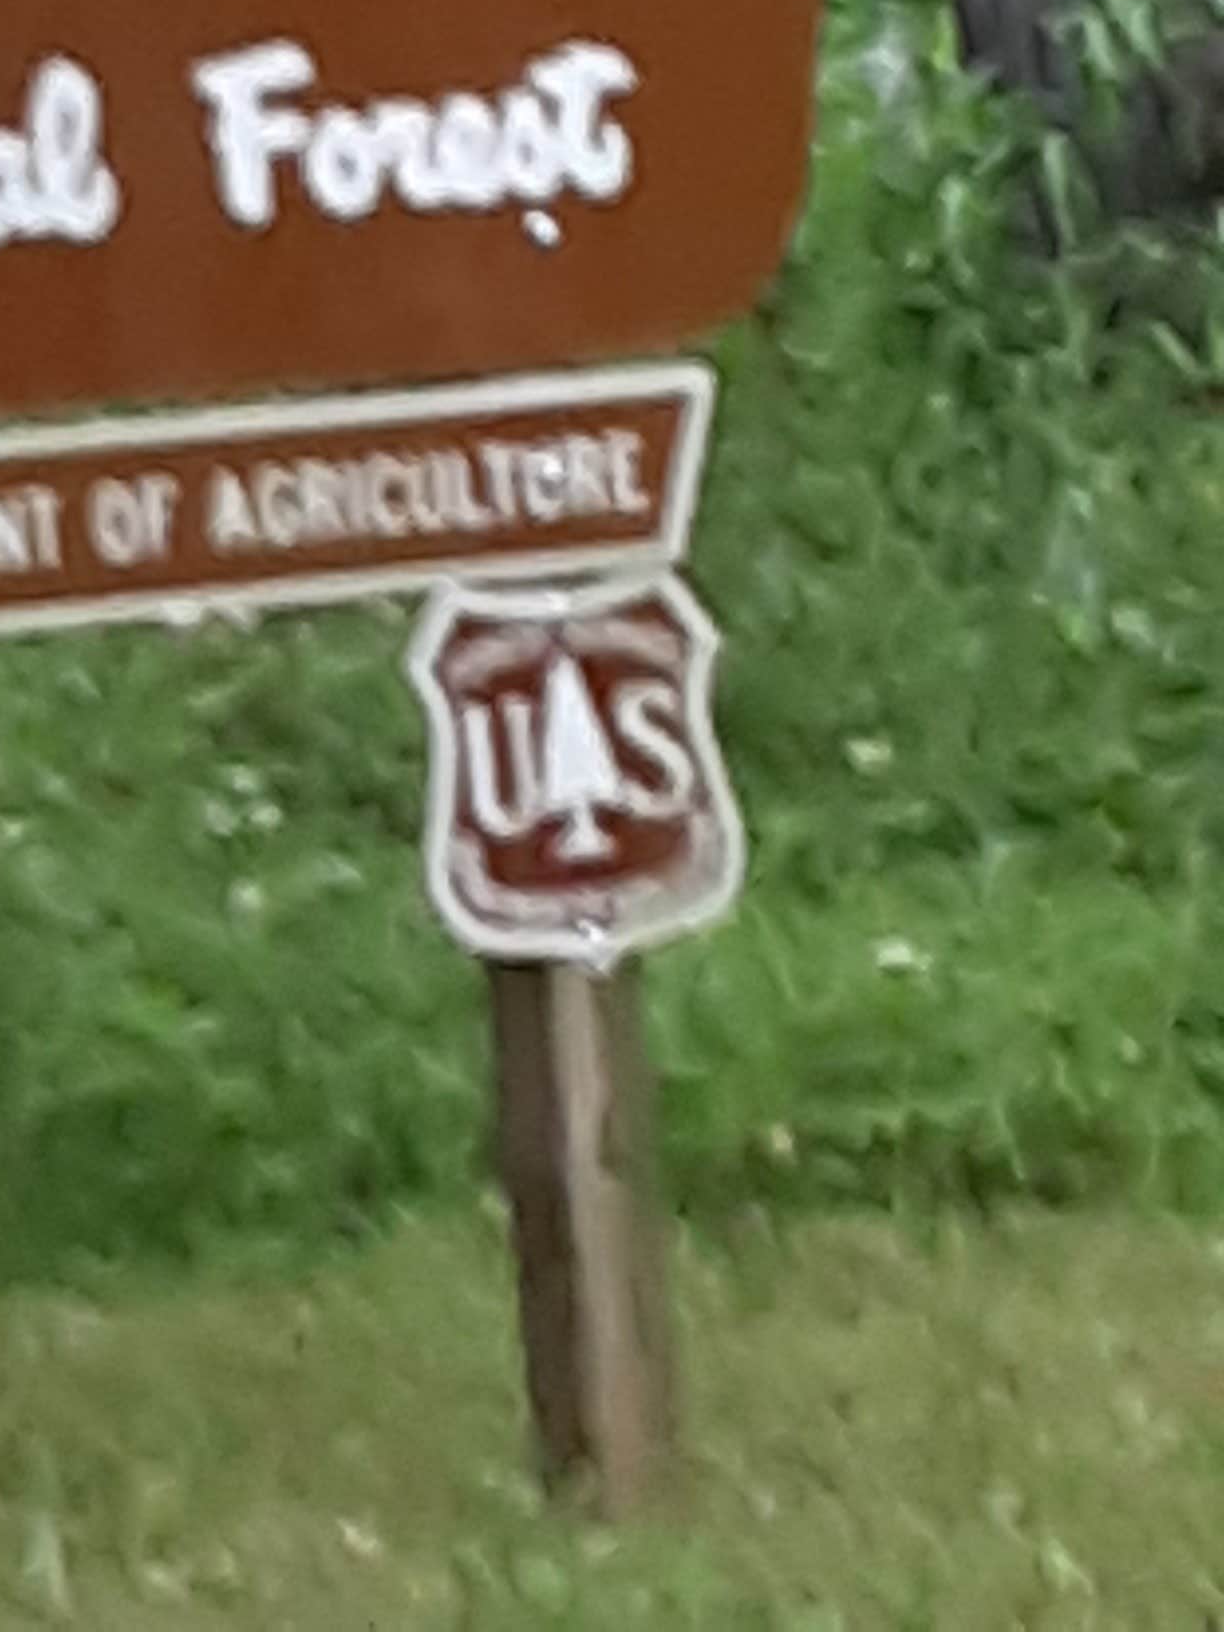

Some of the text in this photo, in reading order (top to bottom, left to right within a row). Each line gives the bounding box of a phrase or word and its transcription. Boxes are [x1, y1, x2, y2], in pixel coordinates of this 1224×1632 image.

[192, 36, 639, 228] Forest
[87, 471, 178, 568] OF
[205, 427, 651, 557] AGRICULTURE
